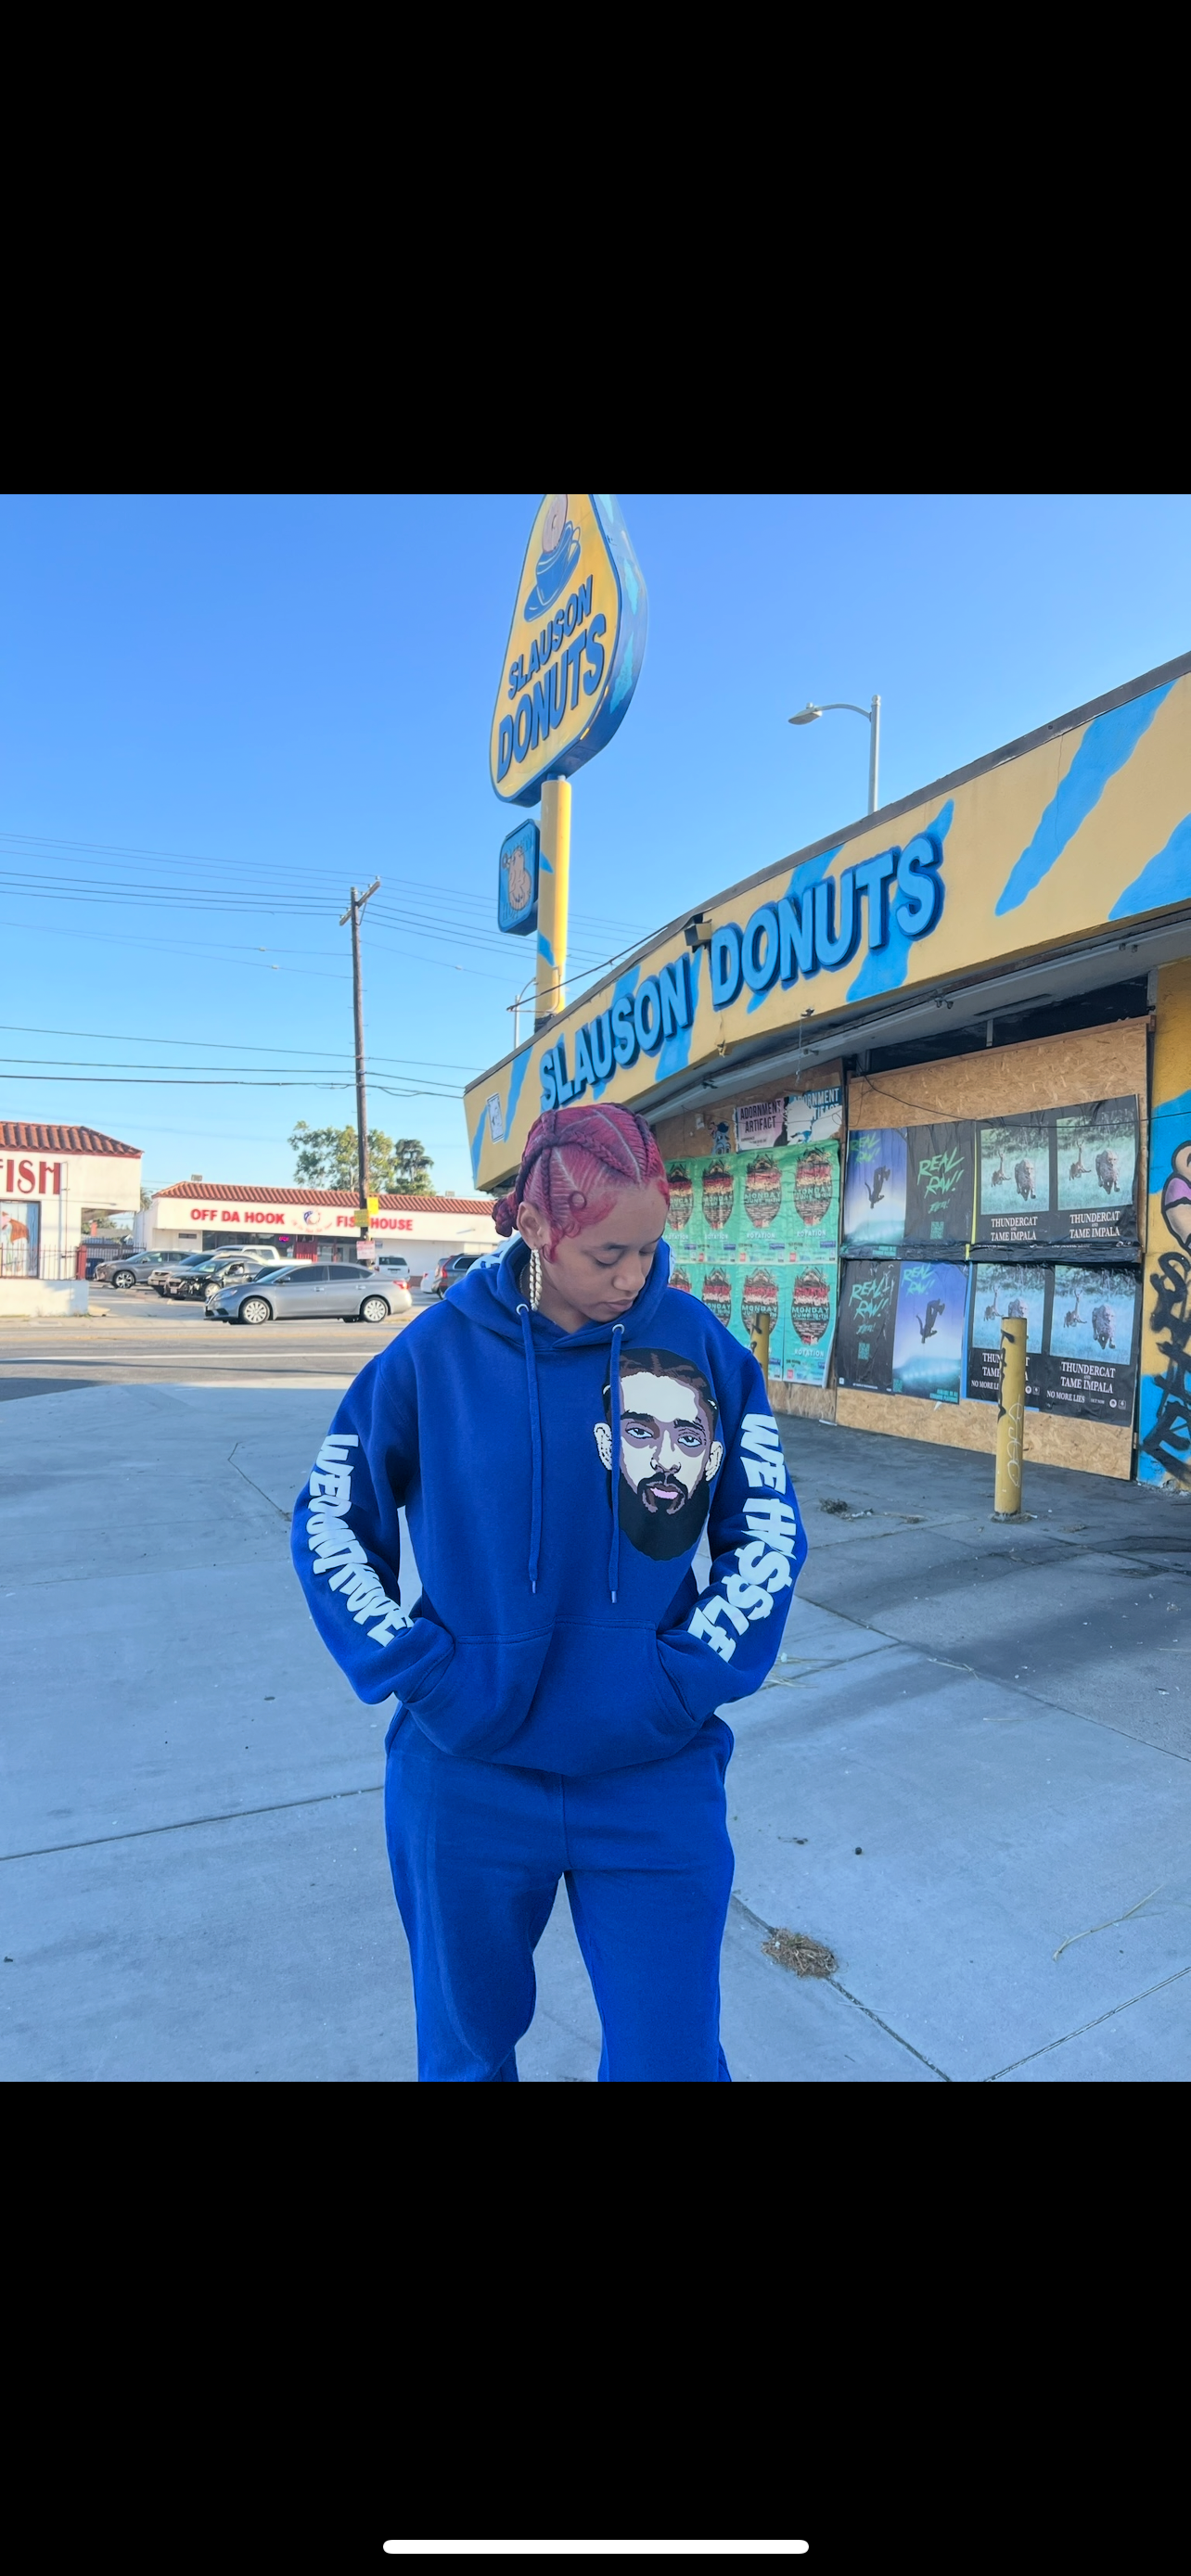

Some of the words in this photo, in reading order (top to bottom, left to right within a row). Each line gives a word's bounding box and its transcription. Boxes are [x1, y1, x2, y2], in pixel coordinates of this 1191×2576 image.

[508, 574, 594, 700] SLAUSON
[496, 613, 607, 784] DONUTS
[539, 951, 694, 1113] SLAUSON
[711, 833, 944, 1011] DONUTS
[793, 1088, 839, 1109] ORNMENT
[740, 1100, 782, 1121] ADORNMENT
[745, 1116, 777, 1133] ARTIFACT
[916, 1146, 965, 1186] REAL
[0, 1159, 61, 1195] ISH
[924, 1169, 965, 1199] RAW!
[744, 1192, 781, 1200] MONDAY
[190, 1208, 217, 1221] OFF
[221, 1210, 240, 1223] DA
[244, 1212, 285, 1225] HOOK
[336, 1216, 356, 1228] FIS
[370, 1218, 414, 1231] HOUSE
[991, 1216, 1038, 1228] THUNDERCAT
[1069, 1210, 1121, 1224] THUNDERCAT
[797, 1230, 826, 1238] ROTATION
[991, 1231, 1009, 1242] TAME
[1010, 1231, 1037, 1241] IMPALA
[1069, 1228, 1090, 1239] TAME
[1092, 1226, 1121, 1238] IMPALA
[901, 1263, 935, 1287] REAL
[905, 1279, 936, 1296] RAW!
[791, 1306, 829, 1314] MONDAY
[853, 1297, 889, 1320] RAW!
[795, 1348, 825, 1358] ROTATION
[982, 1366, 1001, 1378] TAME
[1061, 1361, 1116, 1379] THUNDERCAT
[979, 1381, 993, 1389] MORE
[1060, 1376, 1082, 1389] TAME
[1083, 1379, 1113, 1394] IMPALA
[1046, 1390, 1055, 1398] NO
[1056, 1391, 1072, 1401] MORE
[1073, 1394, 1085, 1403] LIES
[741, 1413, 787, 1494] WE
[310, 1434, 359, 1501] WE
